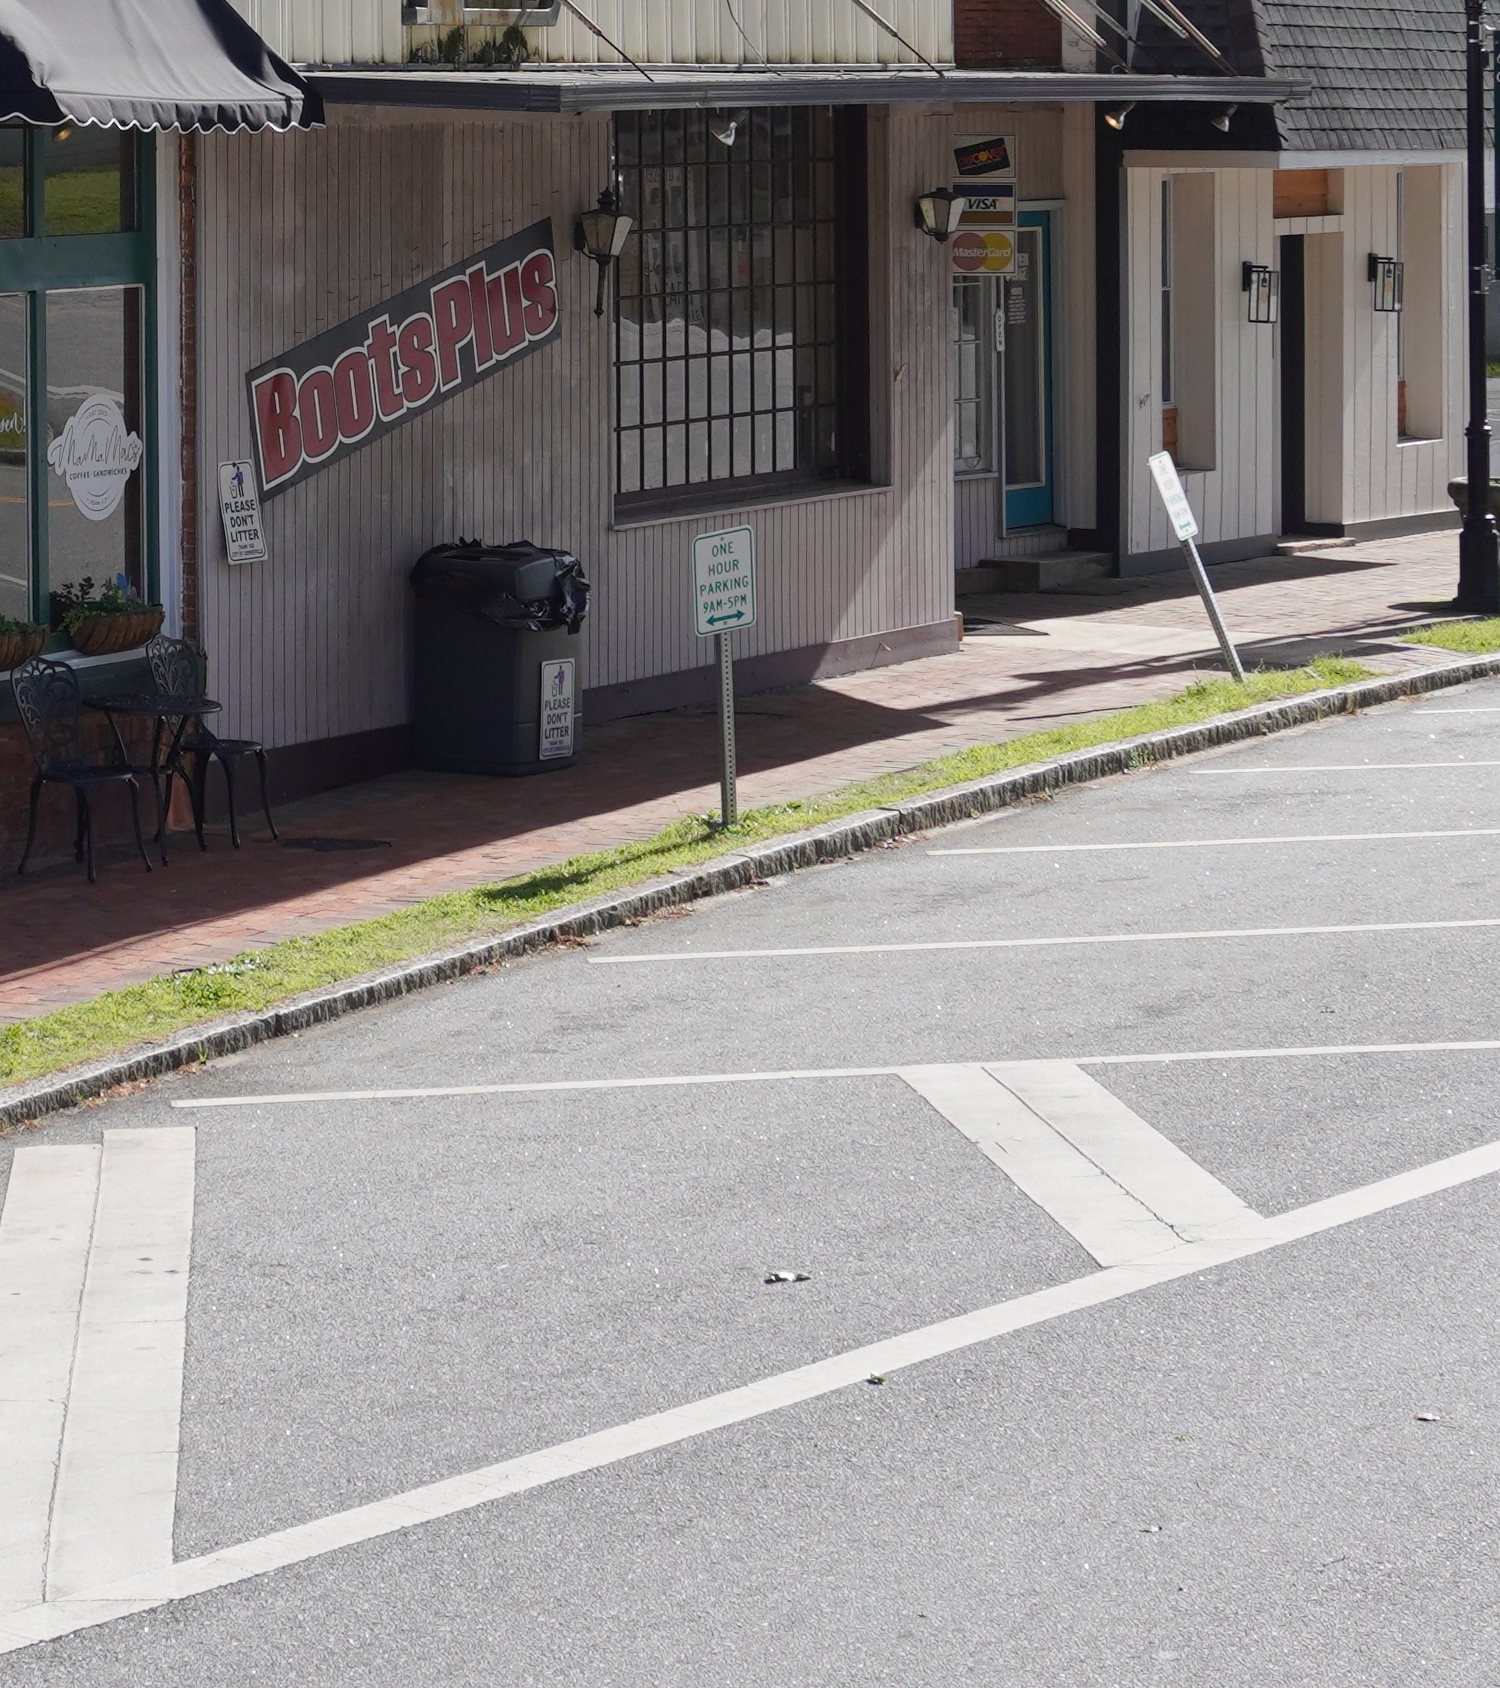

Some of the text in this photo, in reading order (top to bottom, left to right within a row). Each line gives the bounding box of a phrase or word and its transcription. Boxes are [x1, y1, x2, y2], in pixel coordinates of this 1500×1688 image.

[968, 198, 997, 210] VISA
[953, 247, 1011, 257] MasterCard
[69, 468, 127, 480] COFFEE SANDWICHES
[225, 499, 256, 513] PLEASE
[230, 514, 254, 528] DON'T
[230, 529, 259, 543] LITTER
[712, 541, 734, 557] ONE
[708, 559, 739, 577] HOUR
[700, 575, 749, 597] PARKING
[703, 593, 747, 614] 9AM-5PM
[545, 697, 571, 711] PLEASE
[547, 712, 568, 725] DON'T
[544, 726, 570, 739] LITTER
